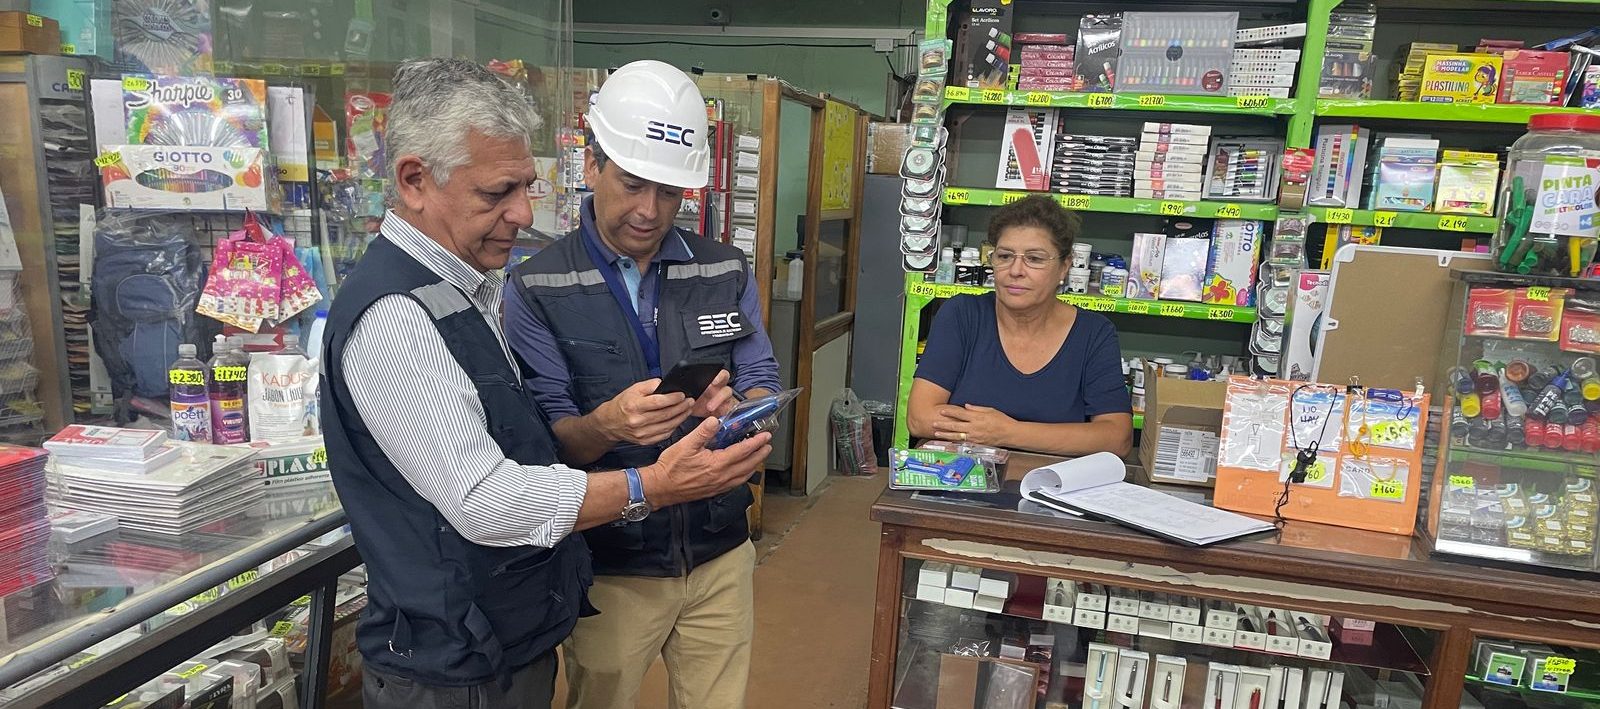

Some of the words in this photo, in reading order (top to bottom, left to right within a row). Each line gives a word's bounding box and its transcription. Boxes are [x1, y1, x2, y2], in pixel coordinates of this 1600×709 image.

[128, 81, 213, 108] Sharpie
[228, 90, 242, 100] 30
[1425, 80, 1470, 92] PLASTILINA
[645, 120, 695, 147] SEC
[154, 152, 212, 164] GIOTTO
[1543, 174, 1593, 191] PINTA
[1543, 187, 1593, 208] CARA
[697, 312, 741, 331] SEC
[261, 371, 311, 388] KADUS
[174, 406, 204, 419] poett
[1302, 405, 1316, 413] NO
[1300, 415, 1320, 424] HAY
